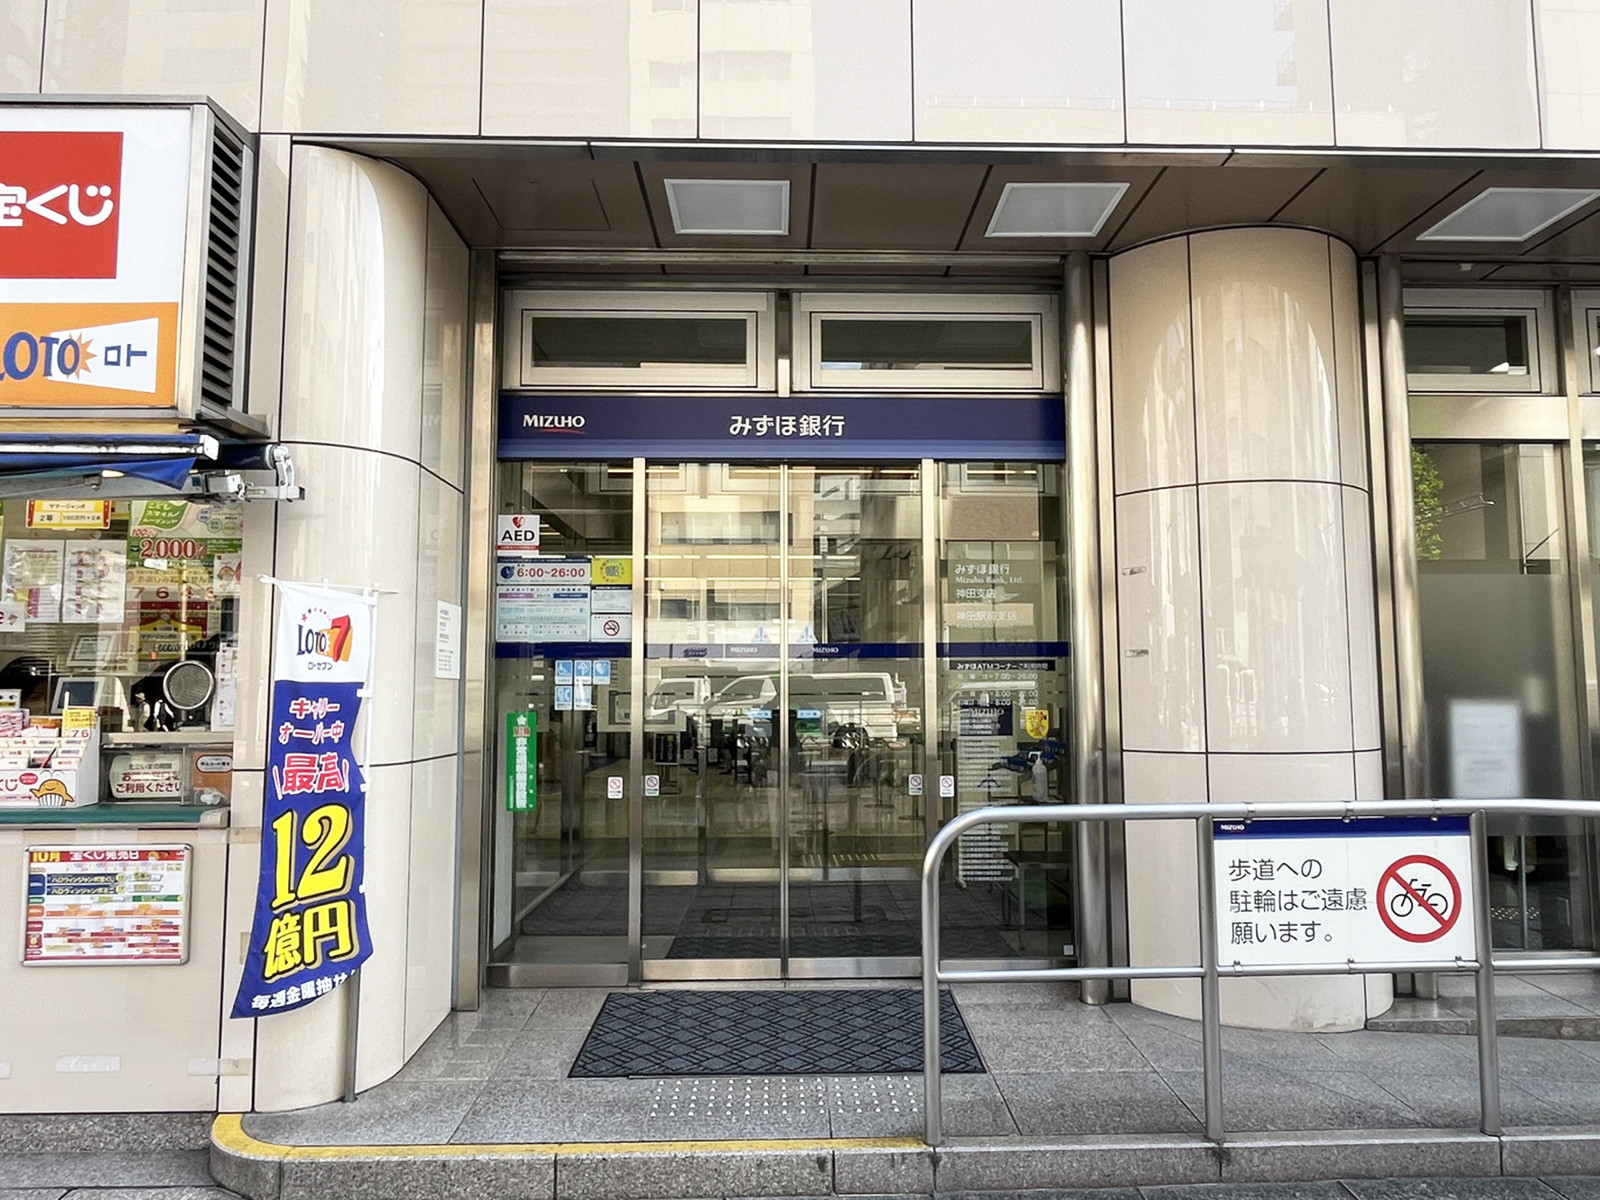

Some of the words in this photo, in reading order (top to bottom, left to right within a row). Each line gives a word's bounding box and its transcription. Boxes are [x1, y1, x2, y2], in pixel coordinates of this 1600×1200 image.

[0, 331, 80, 381] OTO
[104, 343, 148, 367] ロト
[522, 413, 587, 432] MIZUHO
[729, 413, 846, 438] みずほ銀行
[501, 529, 535, 543] AED
[954, 563, 1011, 575] みずほ銀行
[282, 751, 345, 794] 最高
[269, 803, 354, 911] 12
[1228, 858, 1323, 881] 歩道への
[1229, 888, 1368, 913] 駐輪はご遠慮
[263, 899, 359, 981] 億円
[1231, 921, 1333, 945] 願います。
